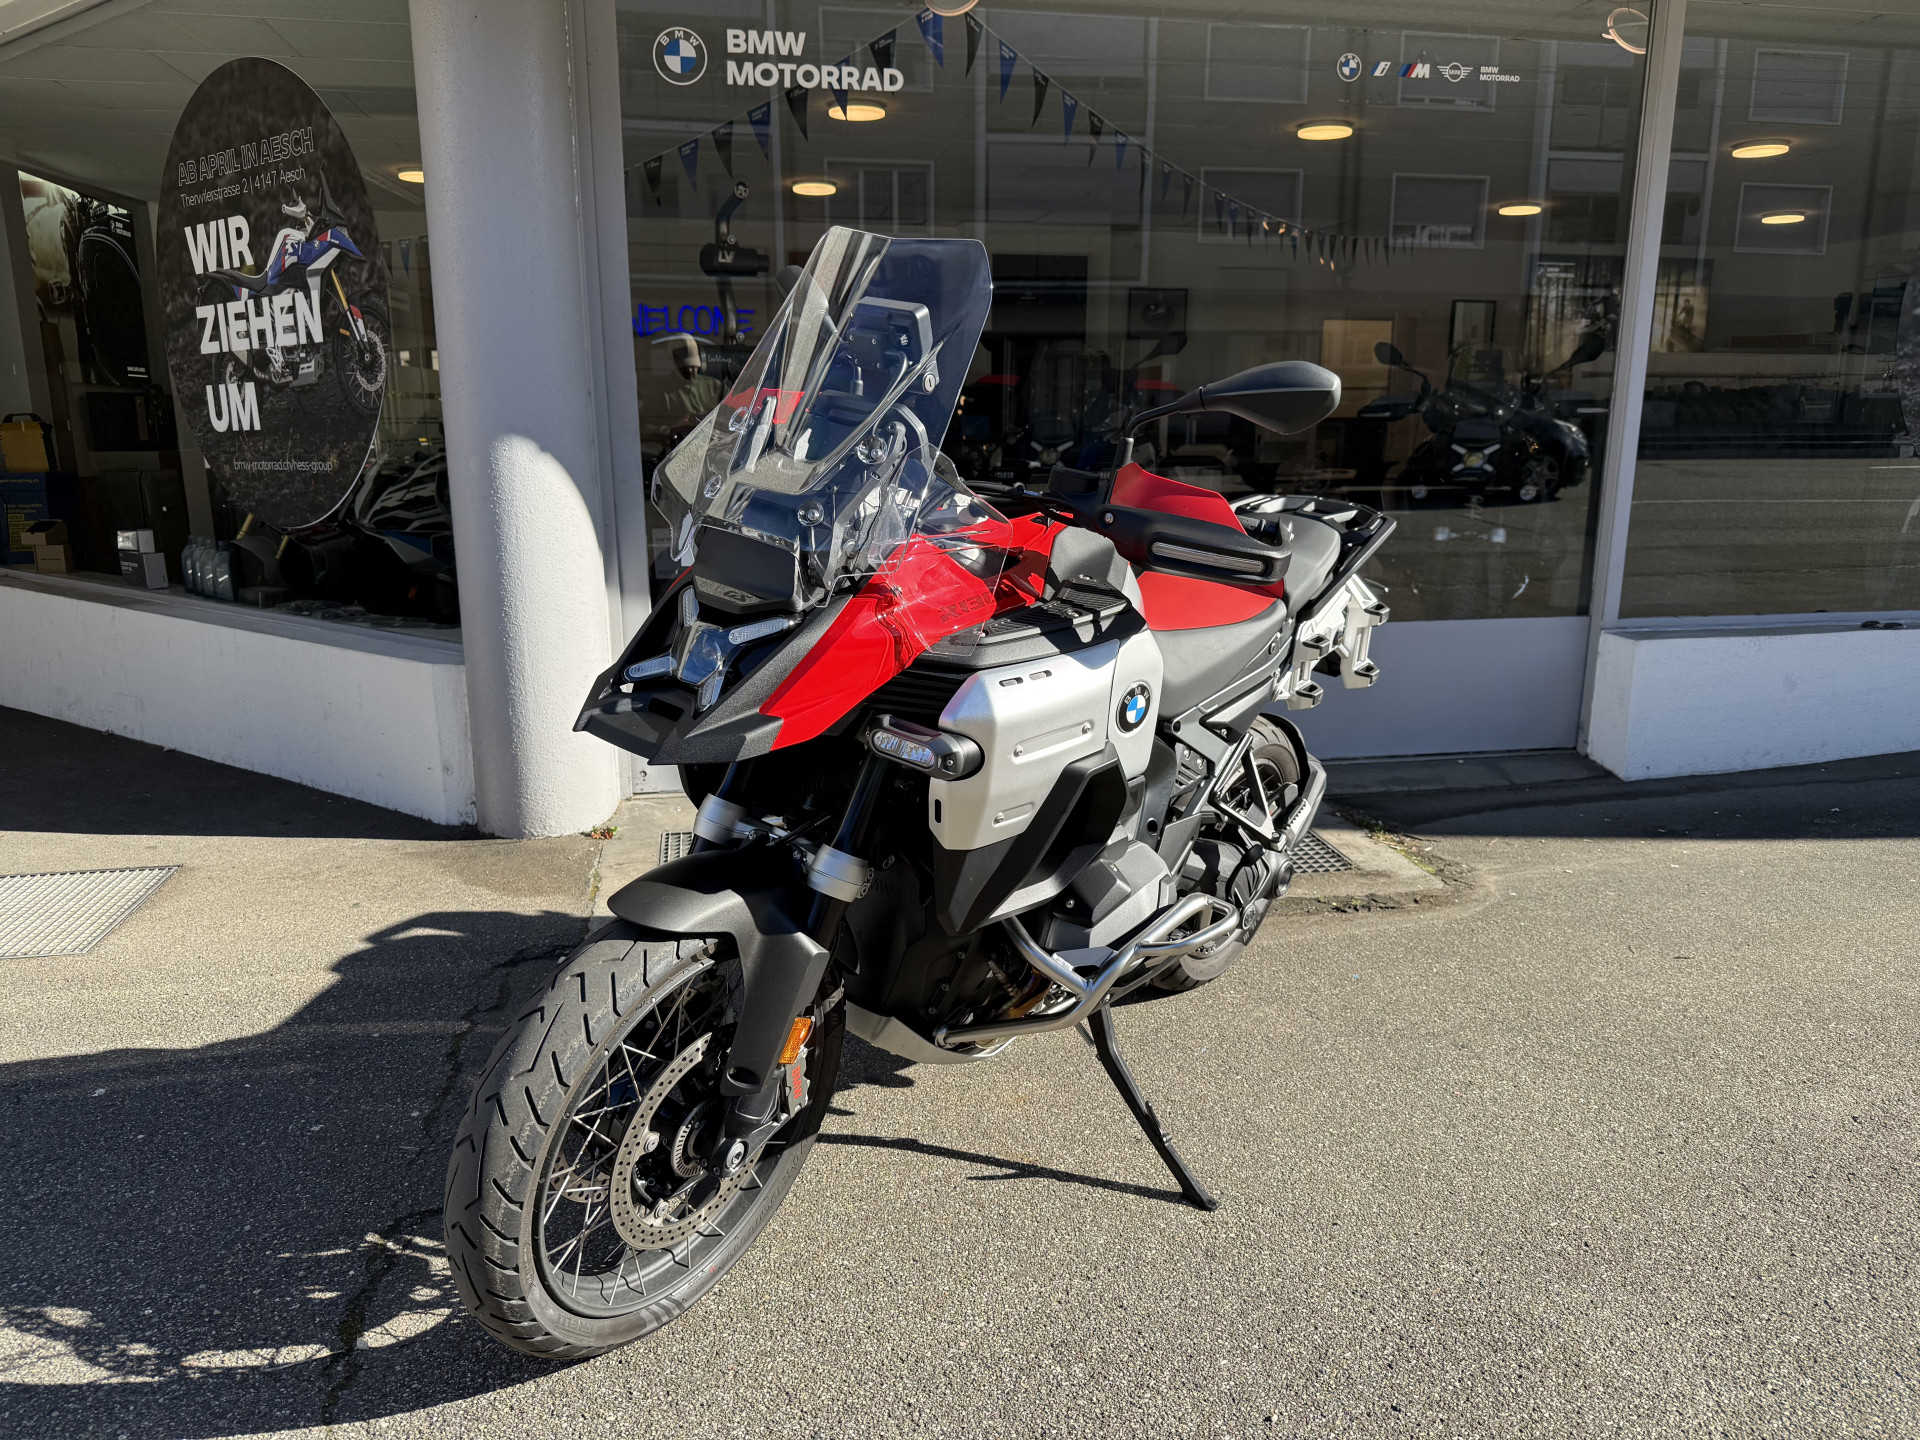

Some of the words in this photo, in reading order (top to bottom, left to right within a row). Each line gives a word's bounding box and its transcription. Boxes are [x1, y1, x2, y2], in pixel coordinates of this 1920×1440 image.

[660, 30, 699, 46] BMW
[726, 29, 806, 57] BMW
[726, 61, 904, 92] MOTORRAD
[1479, 73, 1520, 83] MOTORRAD
[1480, 66, 1499, 74] BMW
[178, 160, 198, 187] AB
[200, 148, 241, 181] APRIL
[241, 142, 258, 170] IN
[260, 126, 314, 165] AESCH
[180, 184, 241, 208] Therwilerstrasse
[242, 177, 249, 194] 2
[254, 170, 277, 190] 4147
[279, 165, 306, 185] Aesch
[184, 214, 254, 275] WIR
[718, 249, 736, 264] LV
[195, 289, 324, 355] ZIEHEN
[205, 381, 262, 433] UM
[233, 458, 333, 474] bmw-motorrad.ch/hess-group
[1124, 686, 1149, 705] BMW
[791, 1064, 803, 1100] BMW
